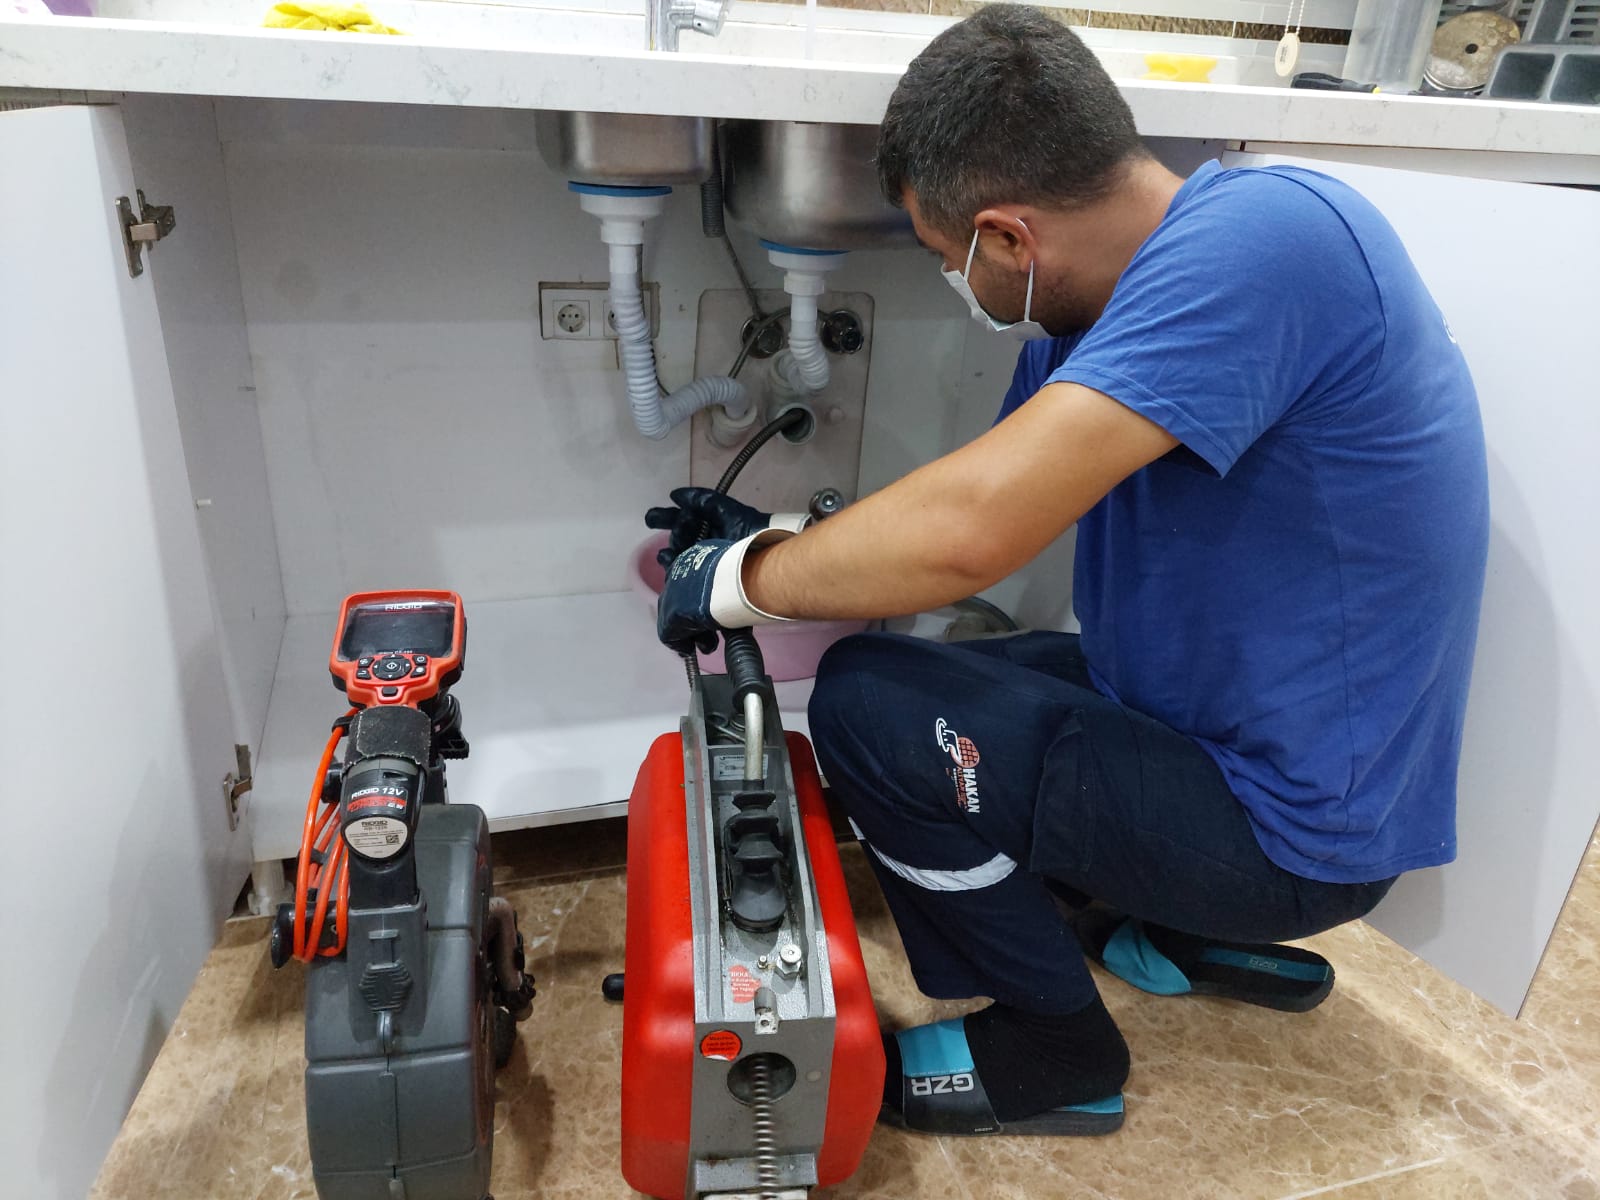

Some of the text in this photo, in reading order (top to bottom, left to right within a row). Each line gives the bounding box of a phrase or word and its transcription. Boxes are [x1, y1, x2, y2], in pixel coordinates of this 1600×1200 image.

[351, 787, 404, 800] RIDGID 12V
[962, 768, 980, 814] HAKAN
[911, 1073, 975, 1096] GZR
